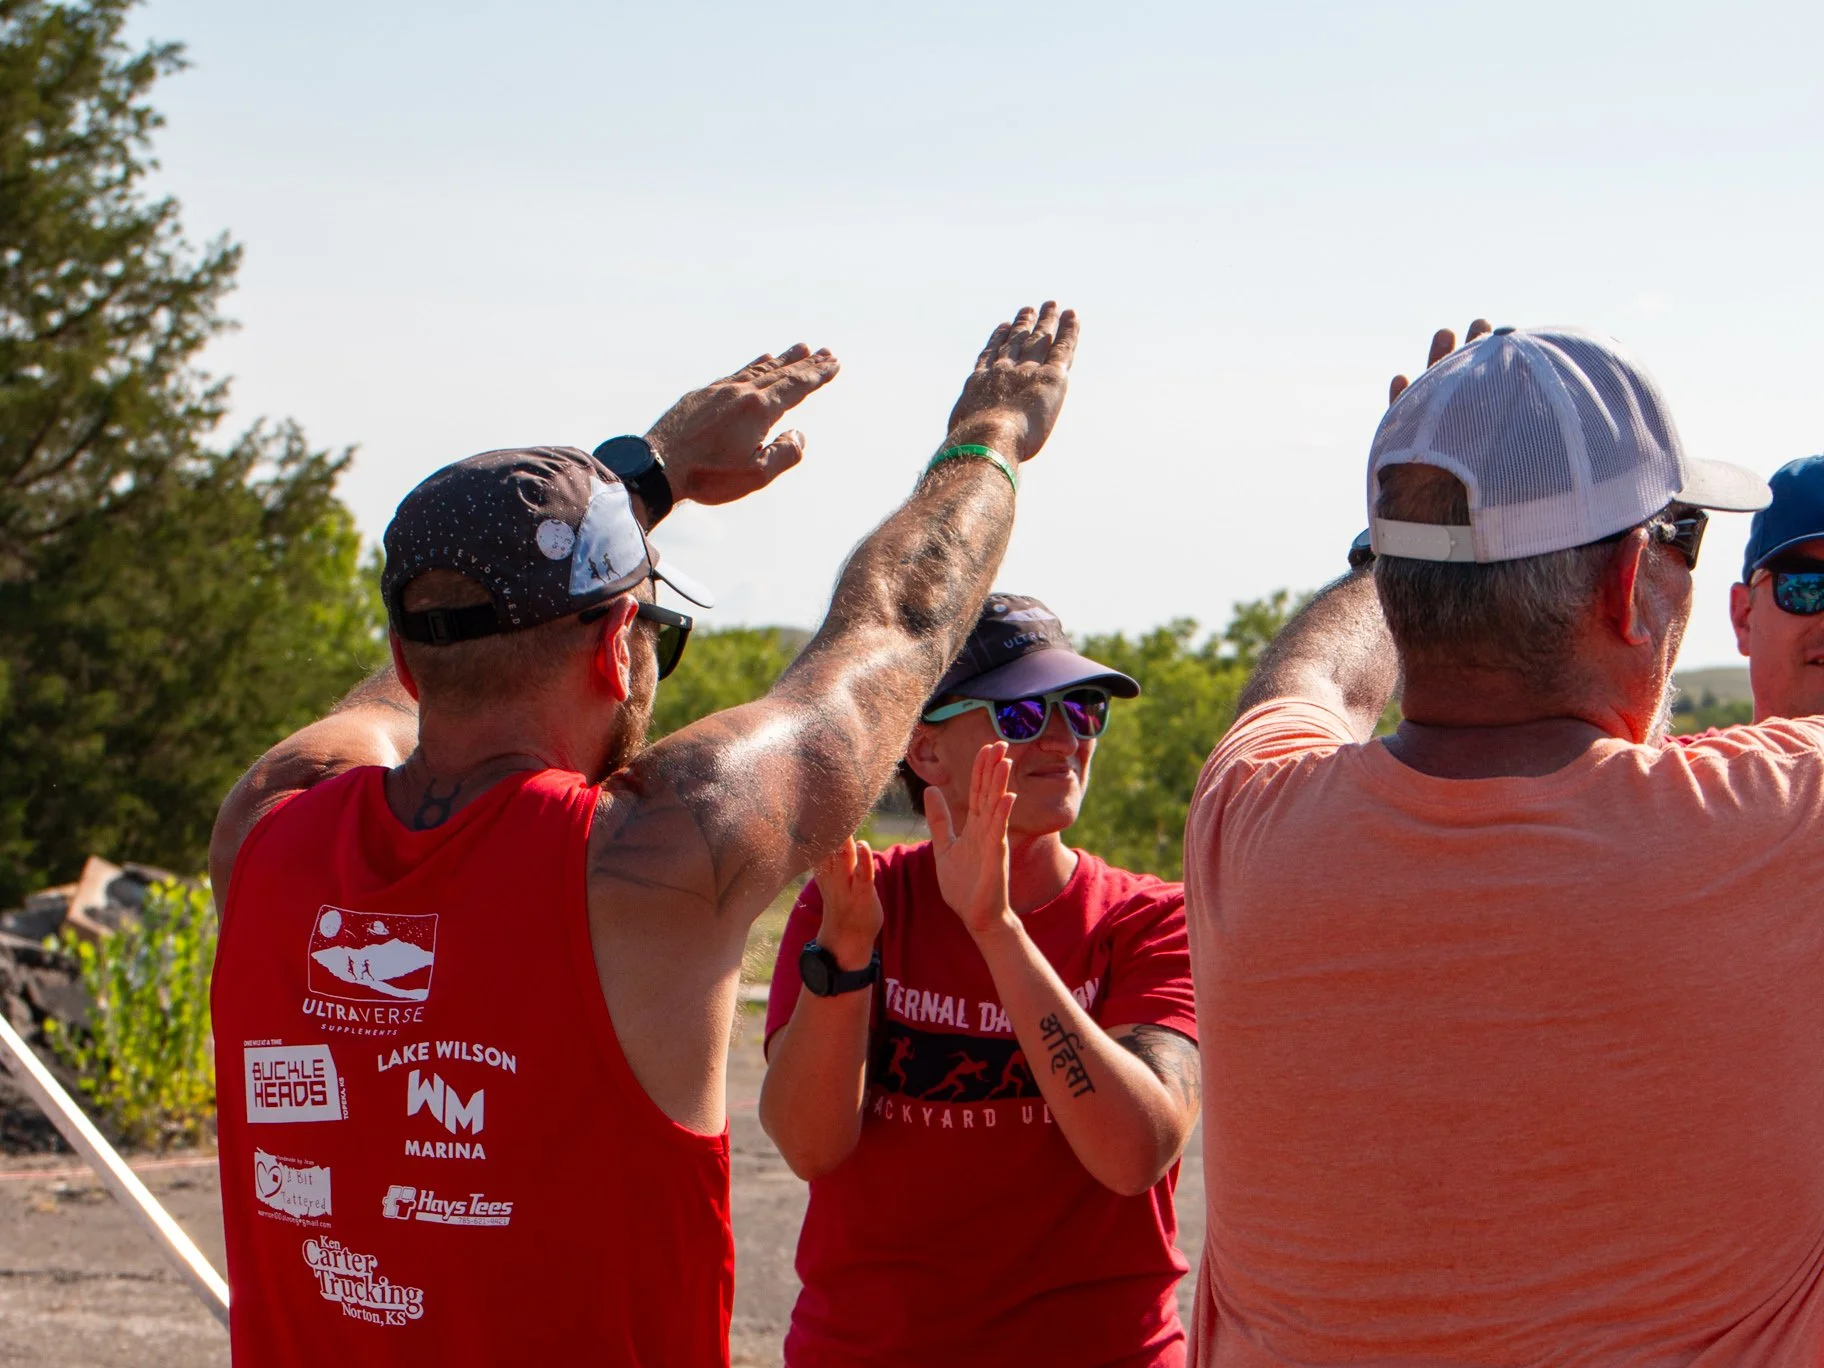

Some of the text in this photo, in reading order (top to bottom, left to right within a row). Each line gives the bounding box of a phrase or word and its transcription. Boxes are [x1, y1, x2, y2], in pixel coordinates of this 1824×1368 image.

[302, 998, 424, 1025] ULTRAVERSE
[885, 977, 969, 1029] TERNAL
[320, 1023, 398, 1036] SUPPLEMENTS
[252, 1059, 324, 1081] BUCKLE
[377, 1040, 517, 1074] LAKE WILSON
[254, 1081, 328, 1108] HEADS
[404, 1139, 486, 1160] MARINA
[418, 1189, 514, 1221] Hays Tees
[319, 1234, 342, 1250] Ken
[302, 1239, 378, 1275] Carter
[314, 1268, 424, 1320] Trucking
[342, 1302, 407, 1327] Norton, KS
